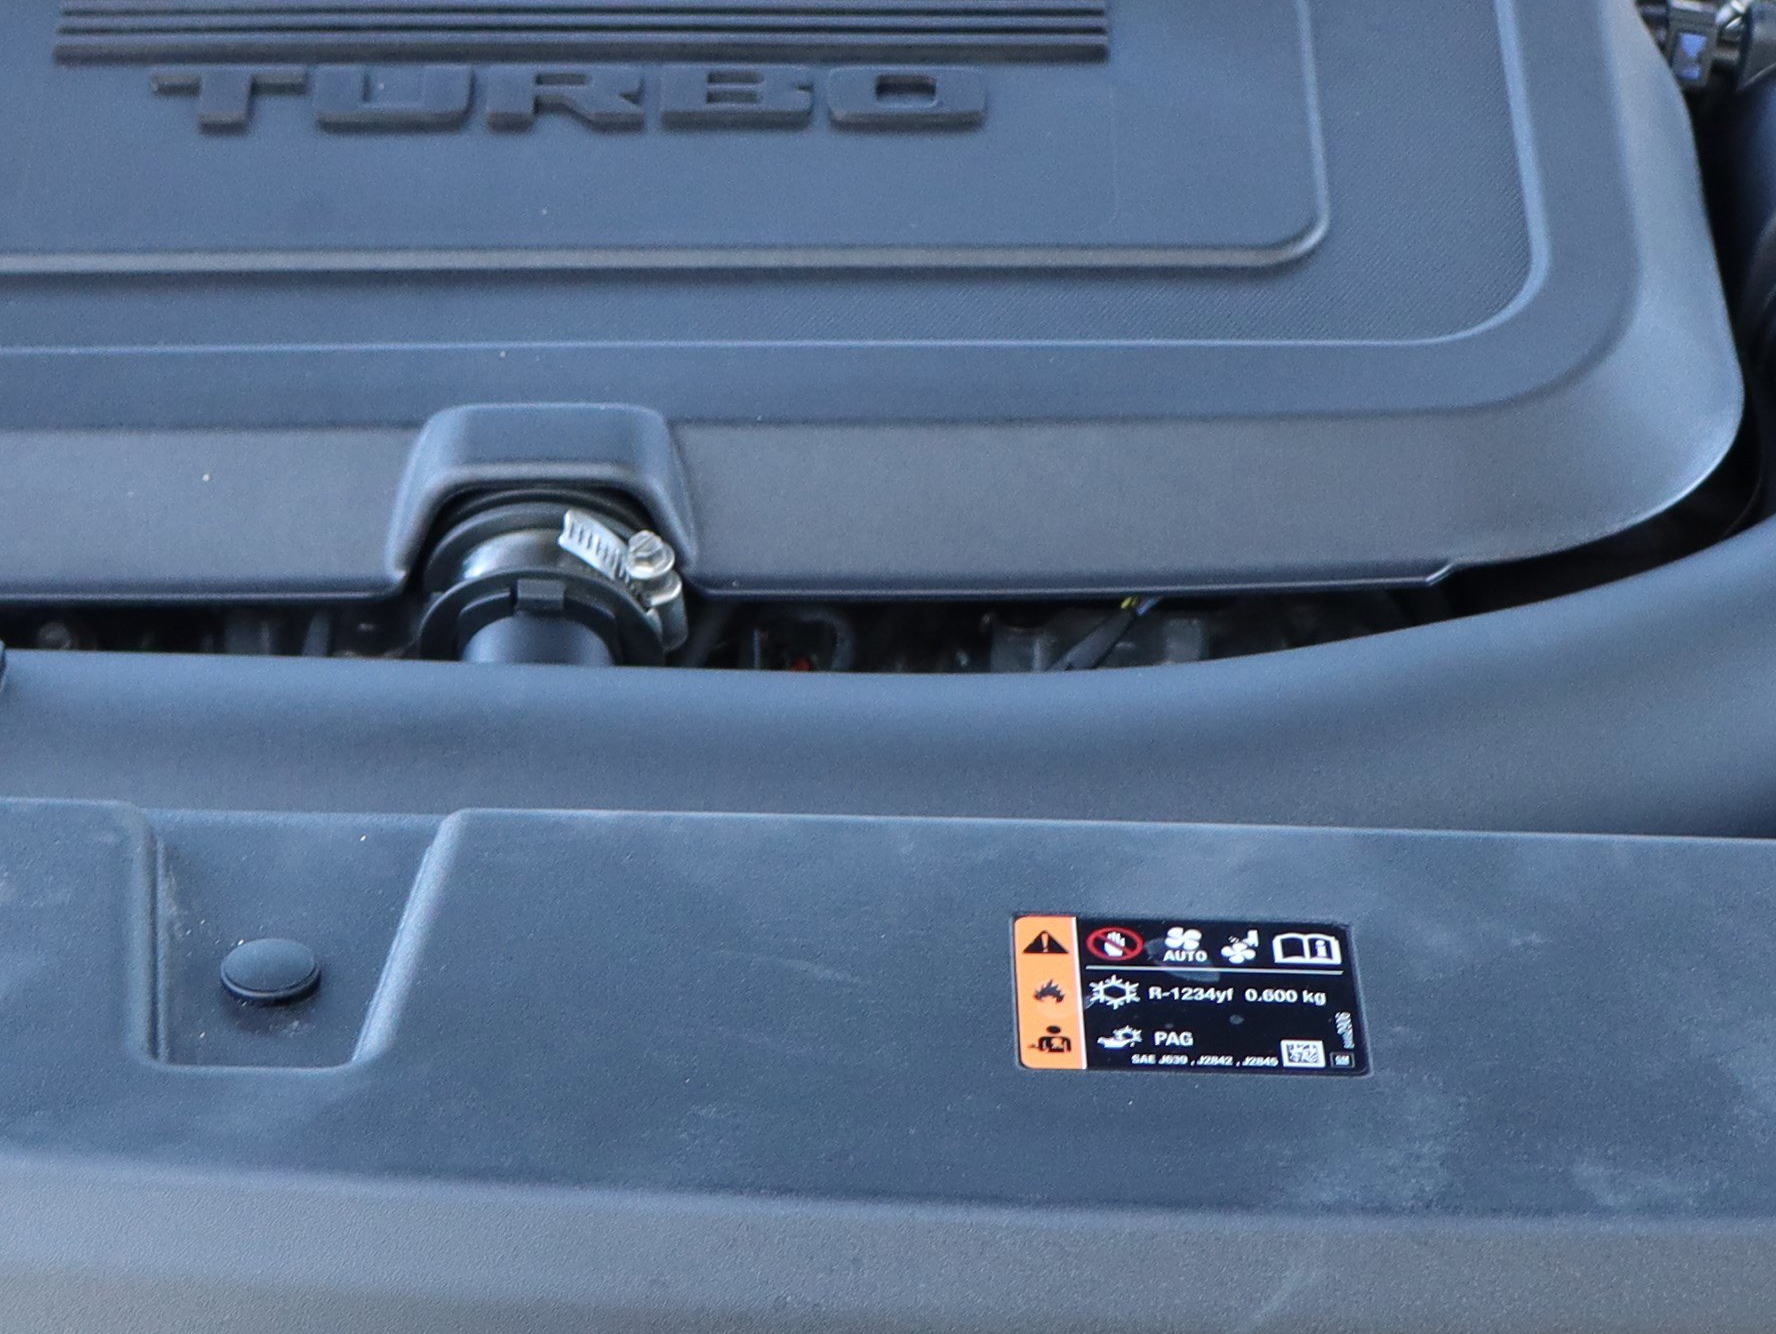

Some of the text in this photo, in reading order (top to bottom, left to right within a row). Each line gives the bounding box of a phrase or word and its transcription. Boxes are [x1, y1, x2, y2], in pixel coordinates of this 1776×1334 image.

[151, 66, 986, 133] TURBO
[1163, 950, 1208, 962] AUTO
[1148, 987, 1326, 1006] R-1234yf 0.600 kg
[1154, 1031, 1193, 1046] PAG
[1131, 1054, 1156, 1065] SAE
